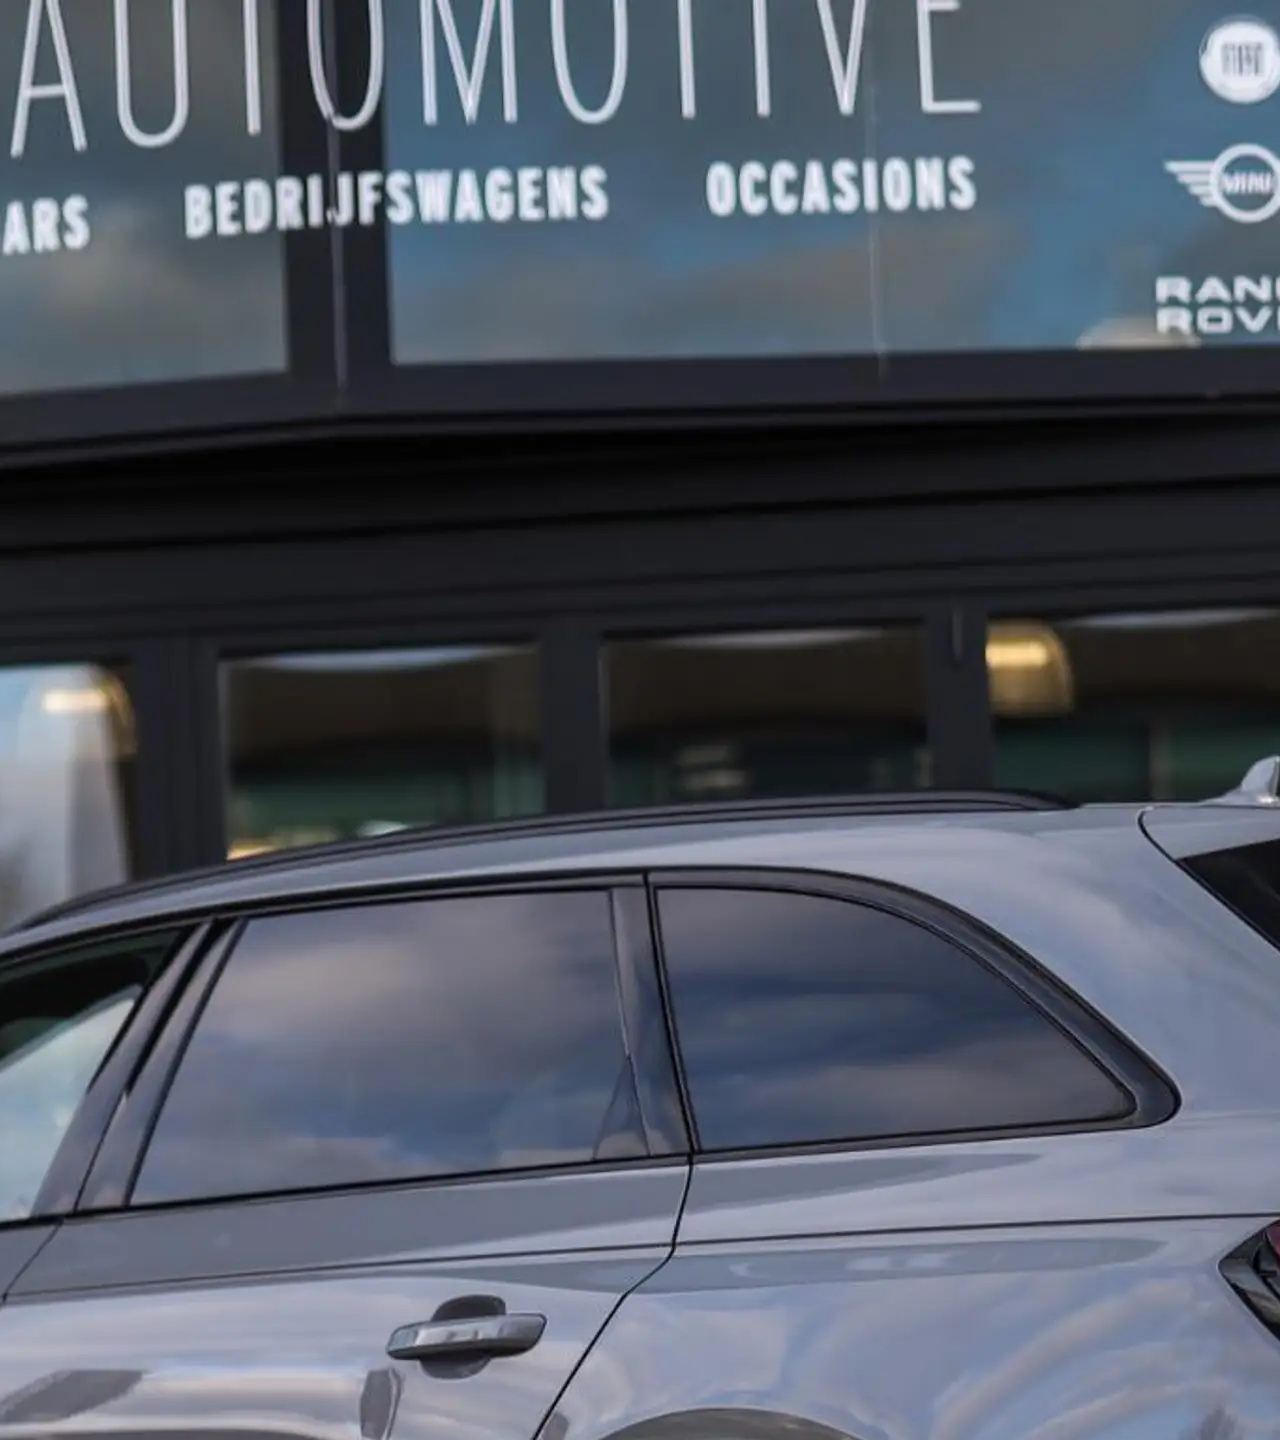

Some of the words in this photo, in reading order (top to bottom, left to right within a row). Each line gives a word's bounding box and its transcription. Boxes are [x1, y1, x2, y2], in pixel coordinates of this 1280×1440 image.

[183, 164, 609, 241] BEDRIJFSWAGENS
[705, 156, 978, 217] OCCASIONS
[1223, 170, 1271, 195] MINI
